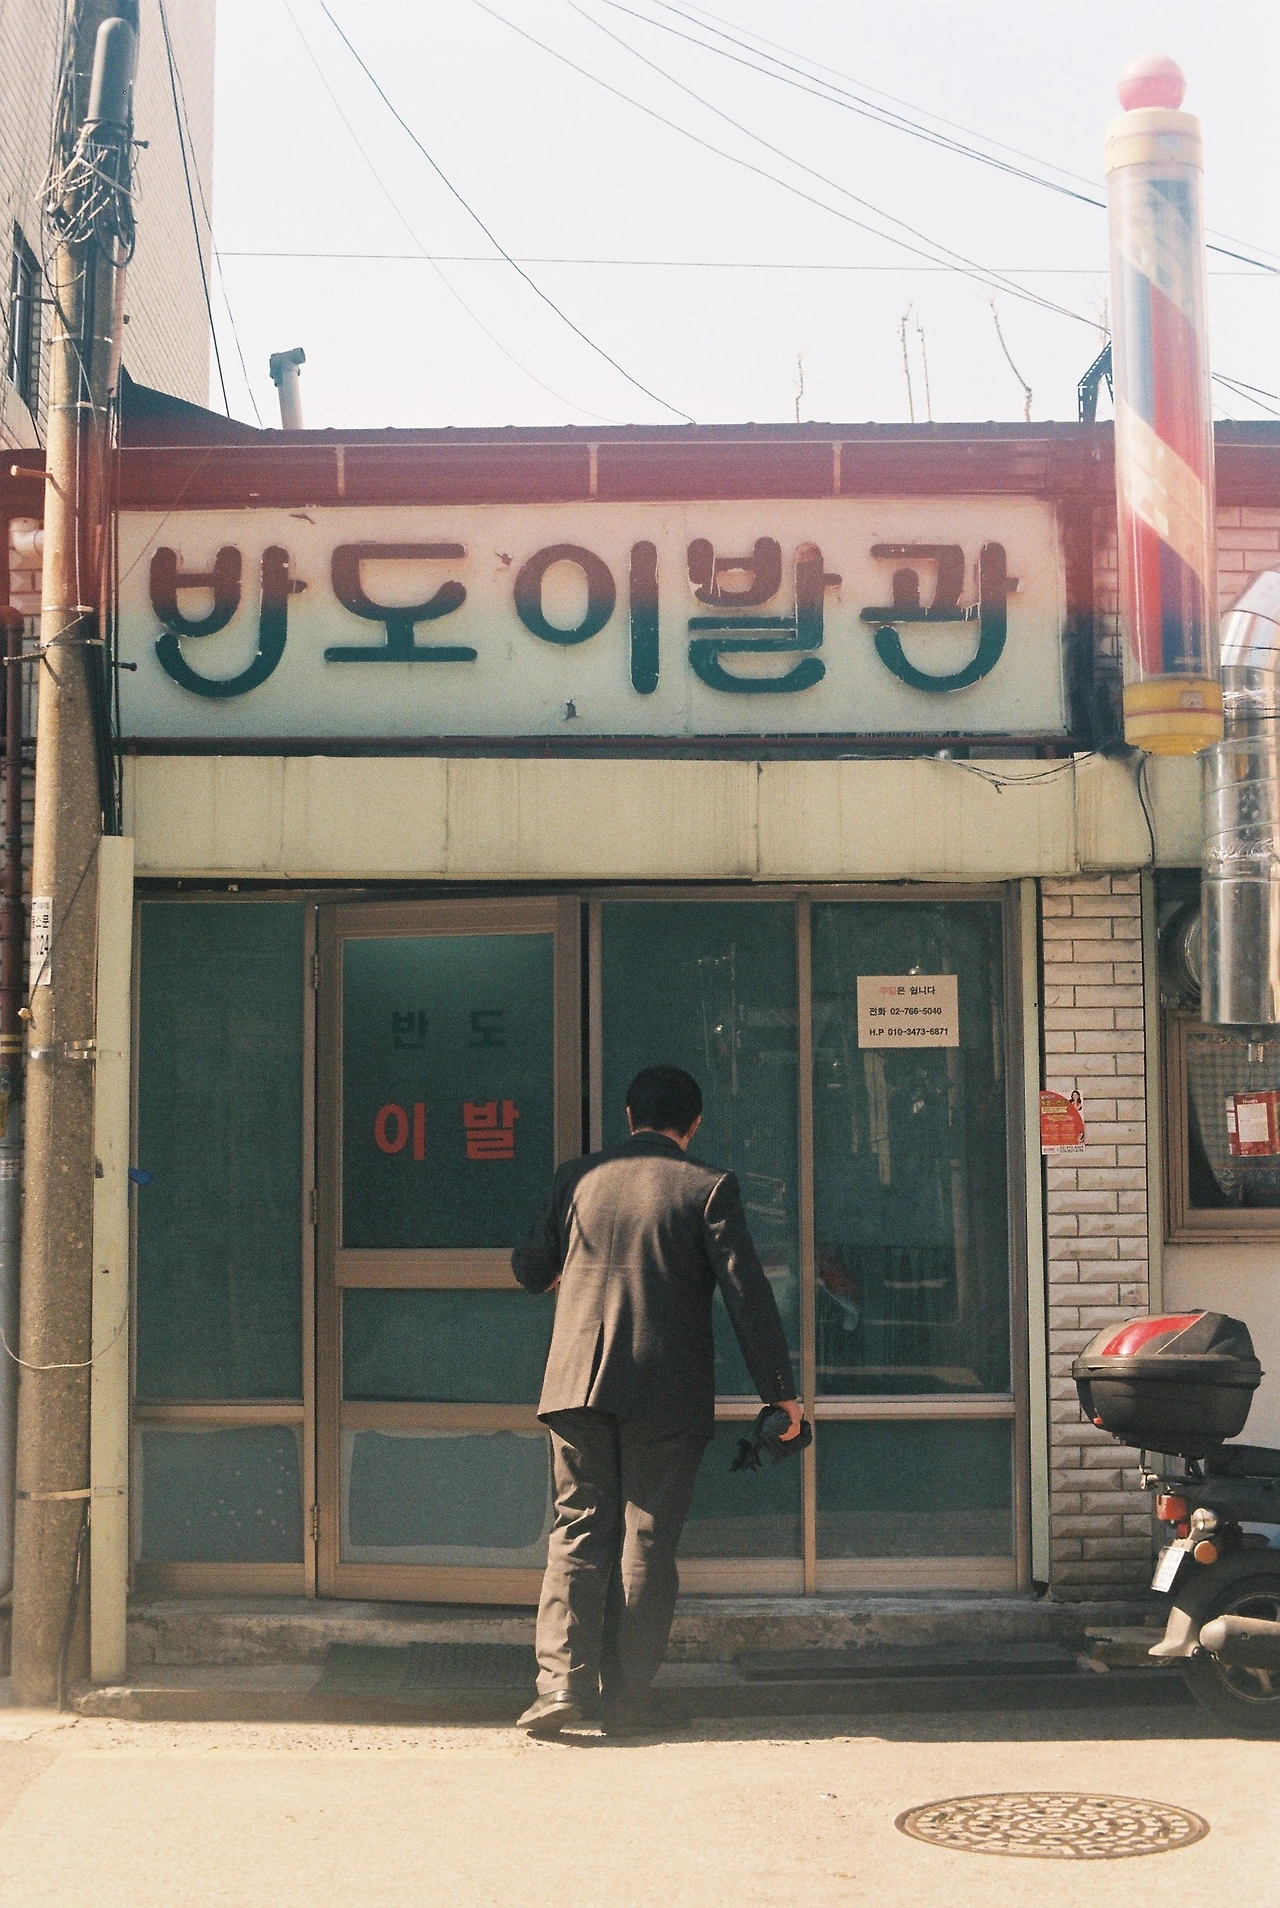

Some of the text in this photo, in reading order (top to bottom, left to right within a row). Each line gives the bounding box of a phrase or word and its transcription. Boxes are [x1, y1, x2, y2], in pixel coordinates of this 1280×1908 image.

[150, 536, 1019, 698] 반도이발관
[910, 985, 936, 996] 쉽니다
[869, 1007, 942, 1016] 전화 02-766-5040
[869, 1028, 949, 1036] H.P 010-3473-6871
